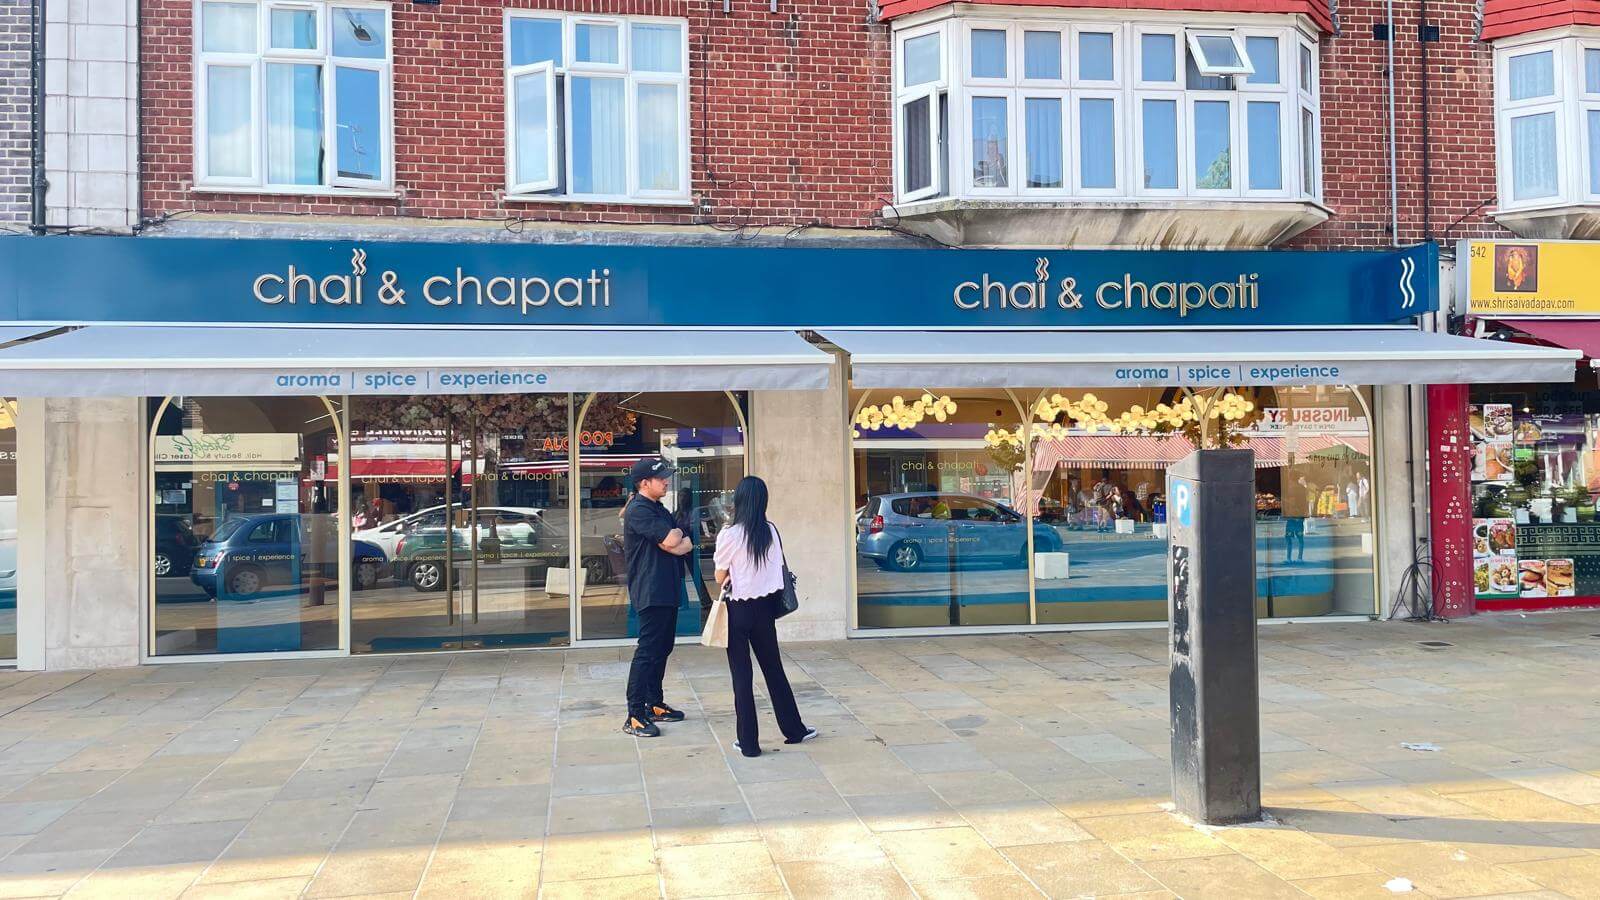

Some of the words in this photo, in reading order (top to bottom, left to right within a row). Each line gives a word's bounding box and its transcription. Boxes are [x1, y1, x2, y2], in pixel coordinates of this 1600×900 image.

[1471, 246, 1487, 258] 542
[253, 248, 367, 305] chai
[378, 270, 406, 305] &
[423, 267, 610, 315] chapati
[953, 257, 1049, 309] chai
[1057, 276, 1084, 309] &
[1095, 272, 1259, 318] chapati
[1470, 297, 1575, 311] www.shrisaivadapav.com
[276, 373, 341, 387] aroma
[365, 371, 417, 389] spice
[440, 370, 547, 388] experience
[1115, 366, 1169, 380] aroma
[1188, 365, 1231, 381] spice
[1250, 364, 1340, 381] experience
[901, 461, 925, 471] chai
[201, 471, 230, 482] chai
[244, 470, 295, 482] chapati
